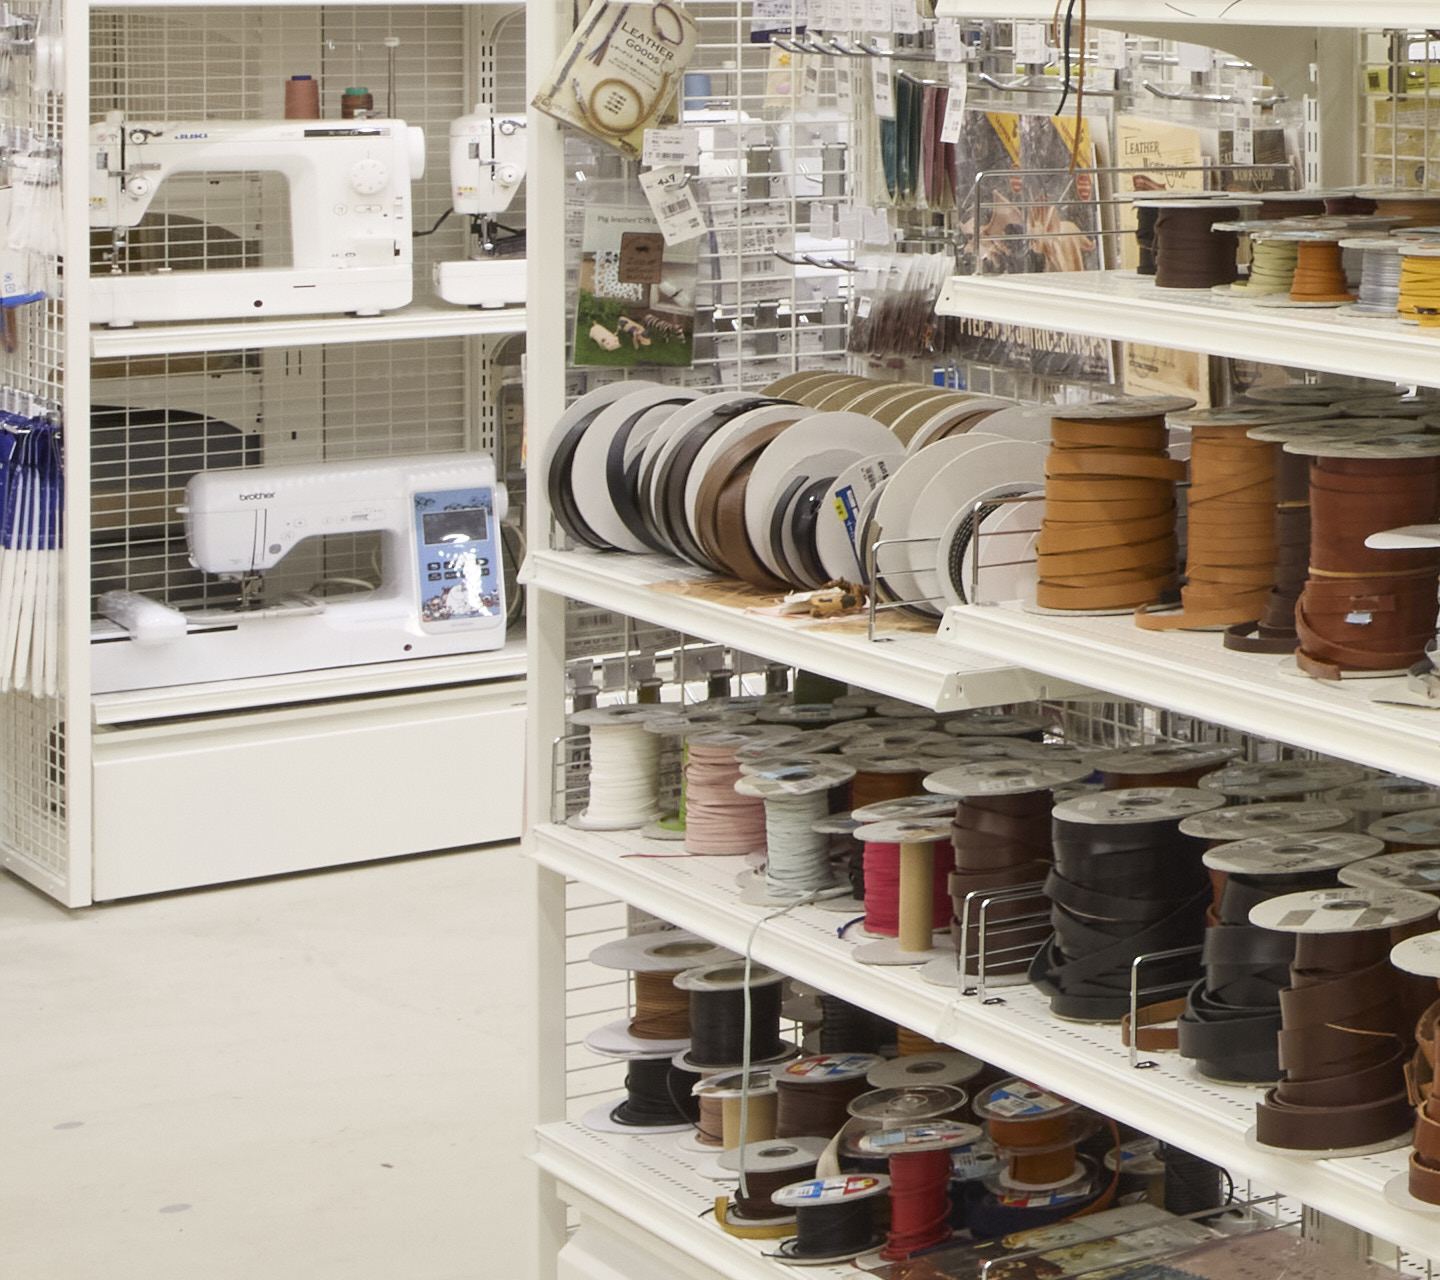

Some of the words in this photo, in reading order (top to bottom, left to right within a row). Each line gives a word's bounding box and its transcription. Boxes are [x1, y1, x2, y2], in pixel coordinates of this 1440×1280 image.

[621, 21, 675, 61] LEATHER
[625, 38, 661, 66] GOODS
[1125, 137, 1160, 157] LEATHER
[239, 493, 276, 502] brother
